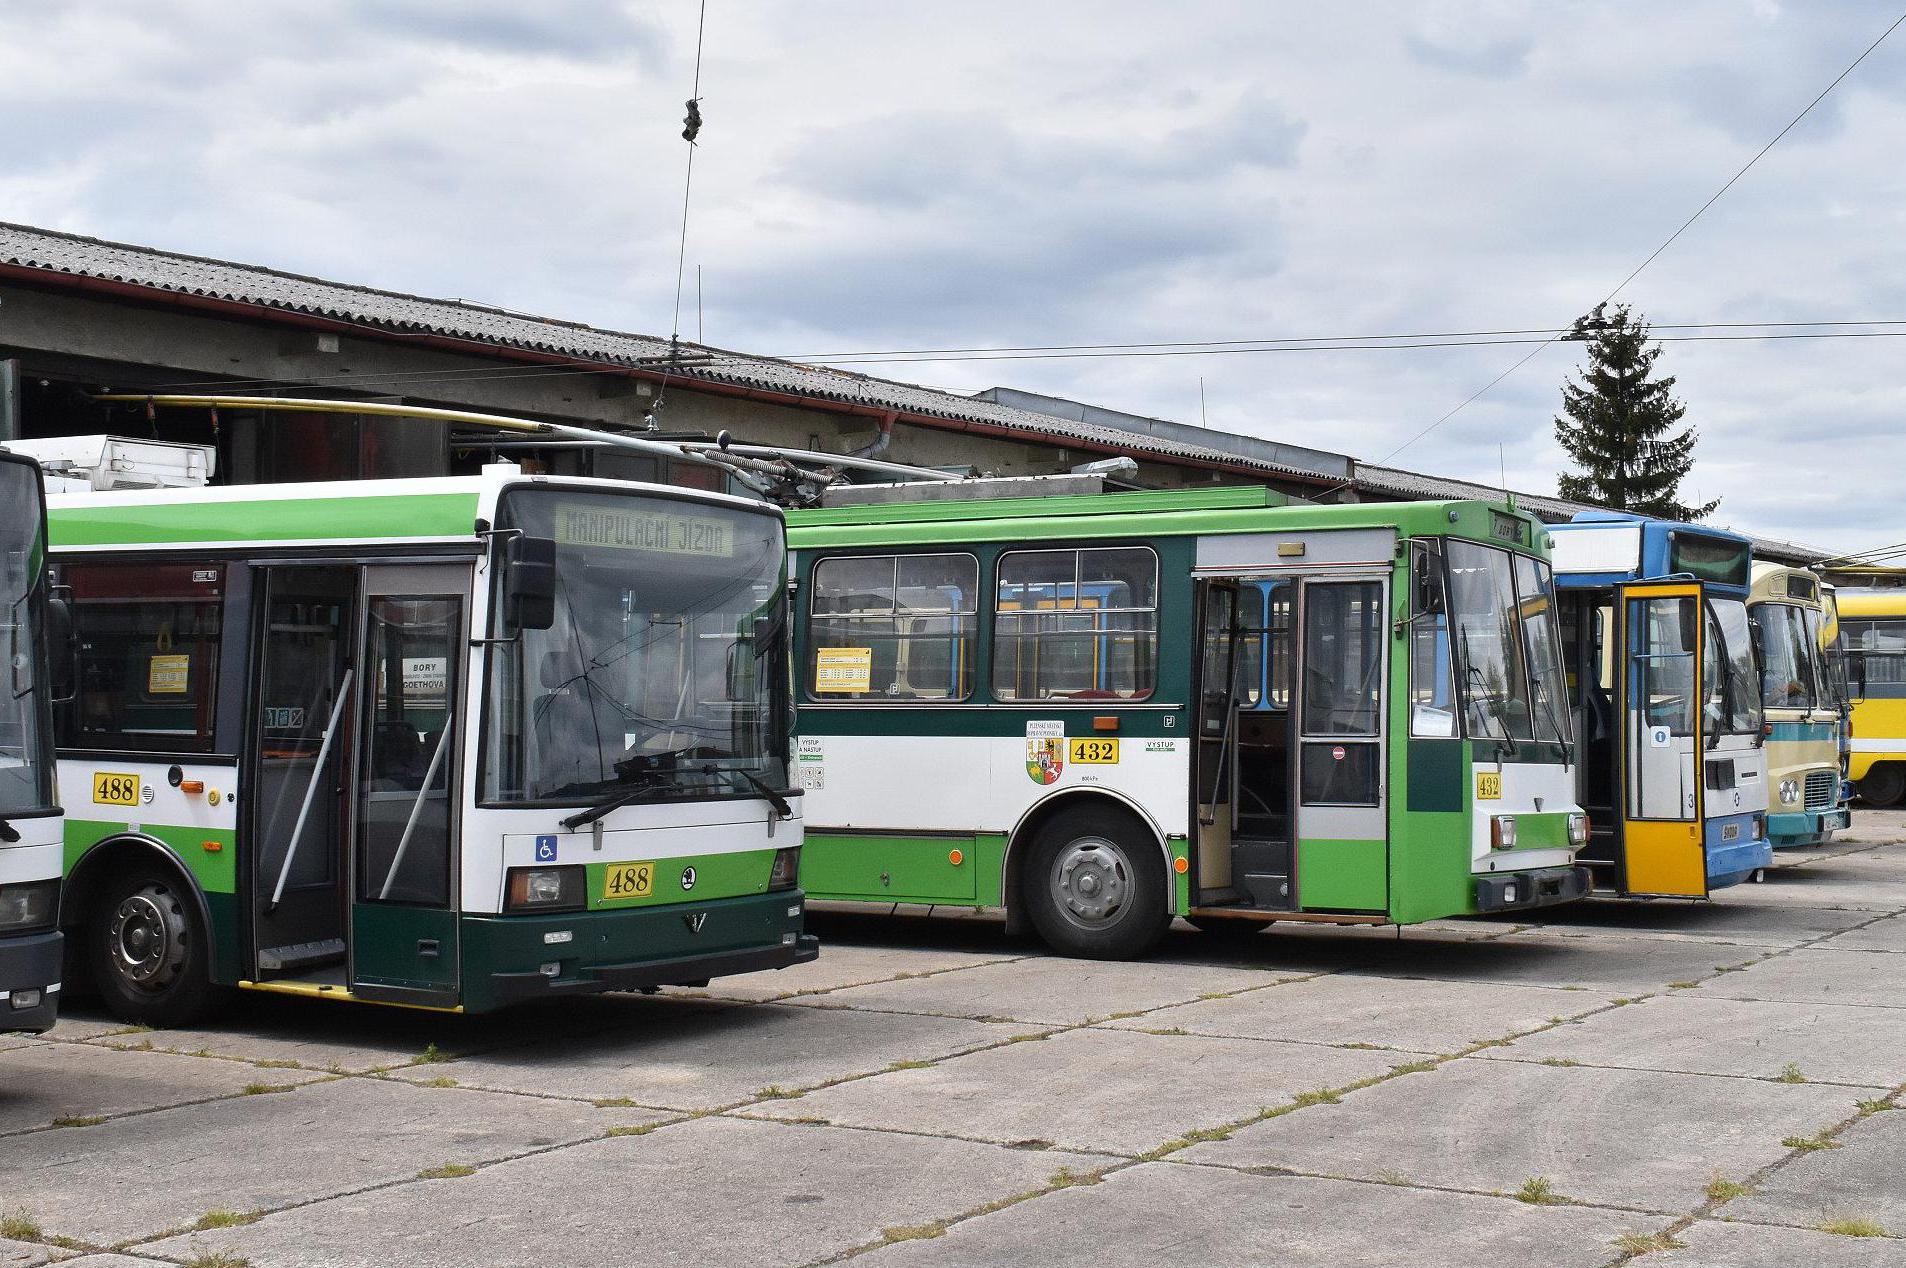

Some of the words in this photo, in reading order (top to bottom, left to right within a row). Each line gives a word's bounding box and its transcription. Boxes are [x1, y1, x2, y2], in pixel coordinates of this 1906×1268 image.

[1074, 742, 1113, 760] 432
[97, 777, 133, 801] 488
[1480, 776, 1499, 796] 432
[609, 867, 649, 893] 488
